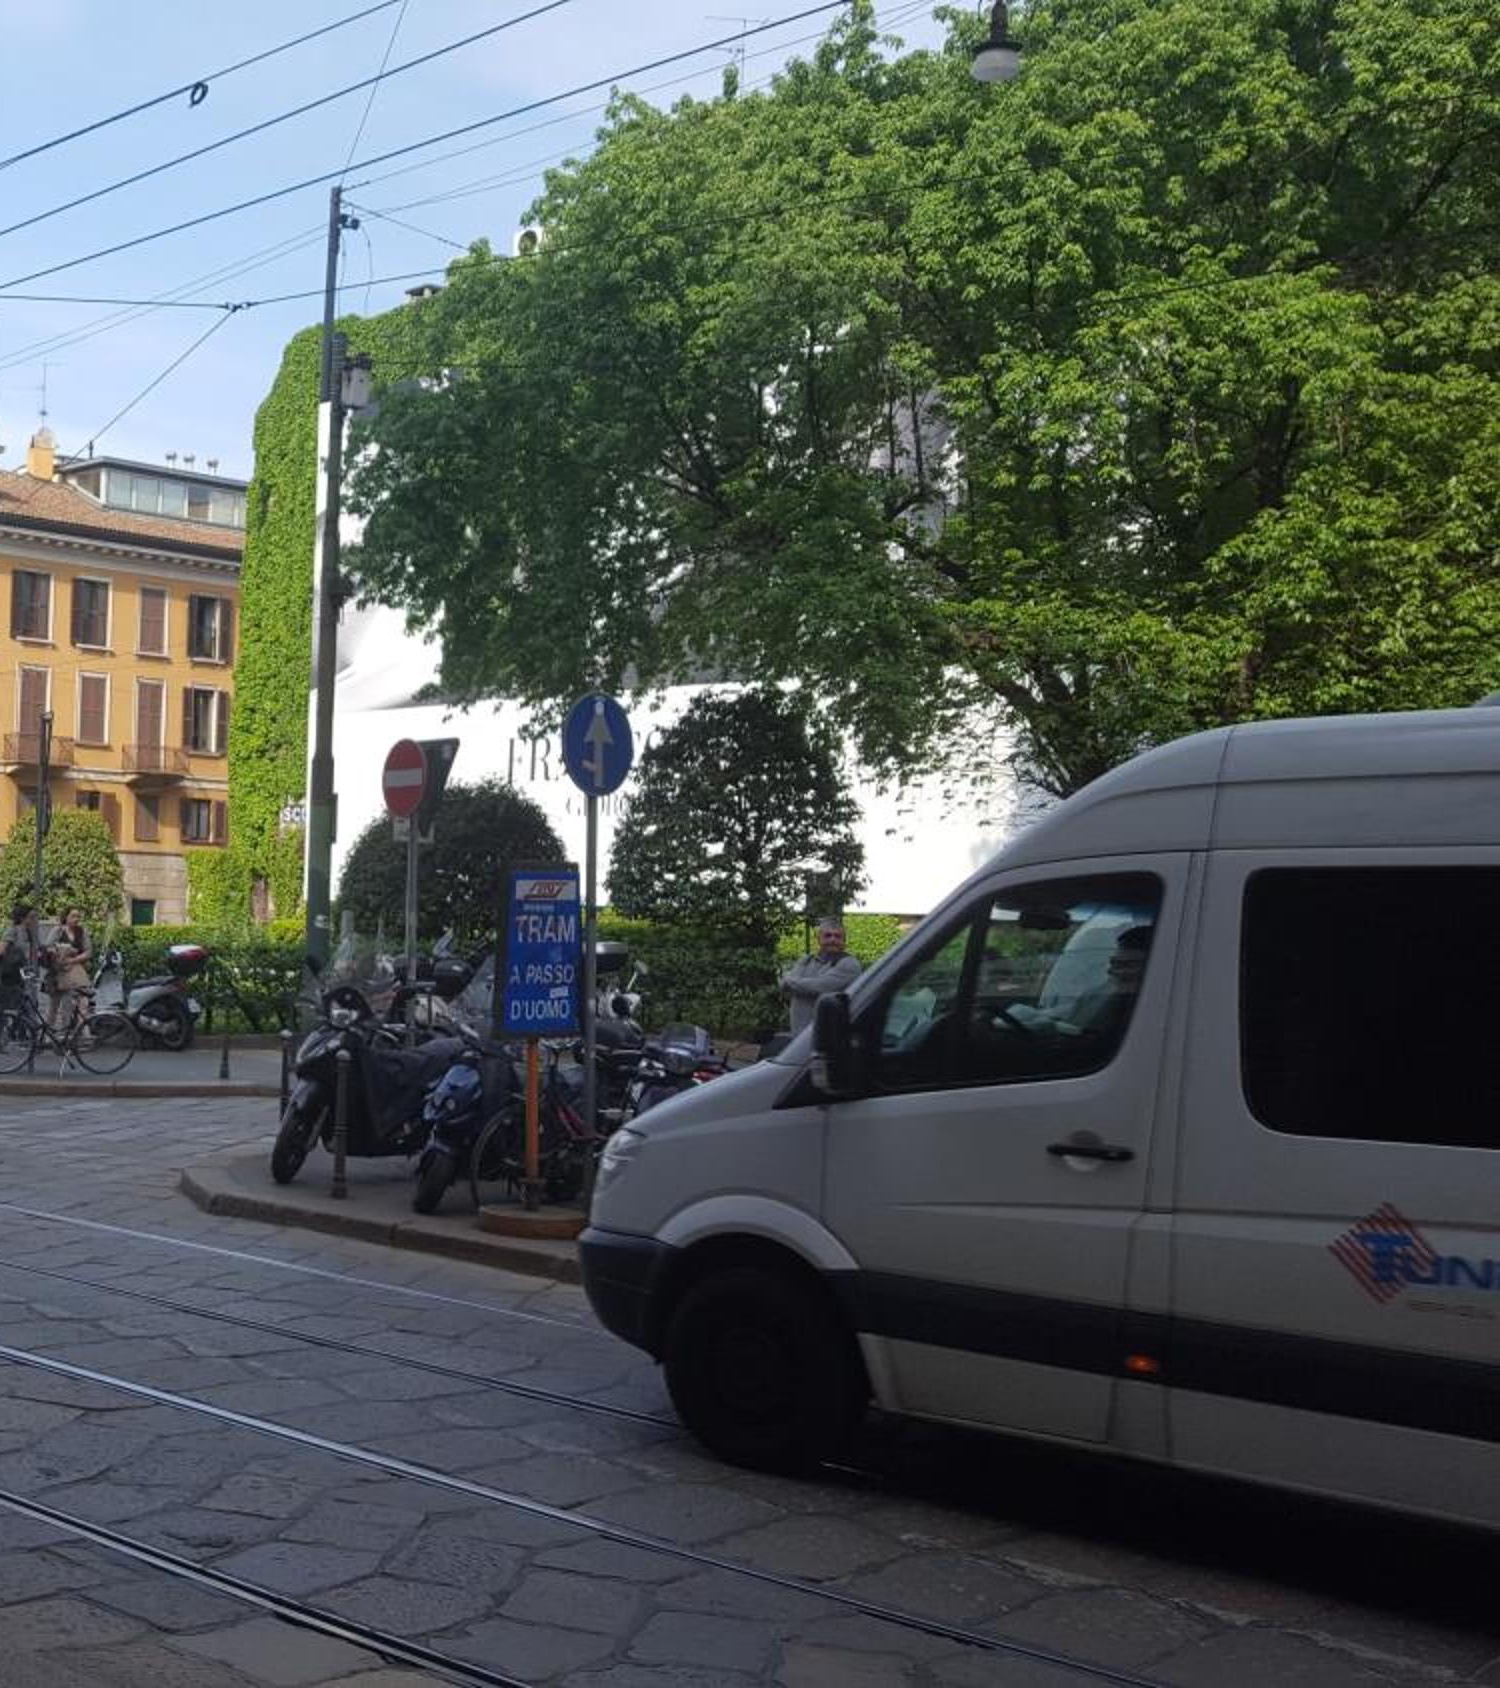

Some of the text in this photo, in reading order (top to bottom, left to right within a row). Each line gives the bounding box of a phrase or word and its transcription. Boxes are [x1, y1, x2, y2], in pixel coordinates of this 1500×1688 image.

[515, 914, 575, 944] TRAM
[510, 962, 575, 986] A PASSO
[510, 999, 570, 1022] D'UOMO
[1350, 1230, 1500, 1290] TUN
